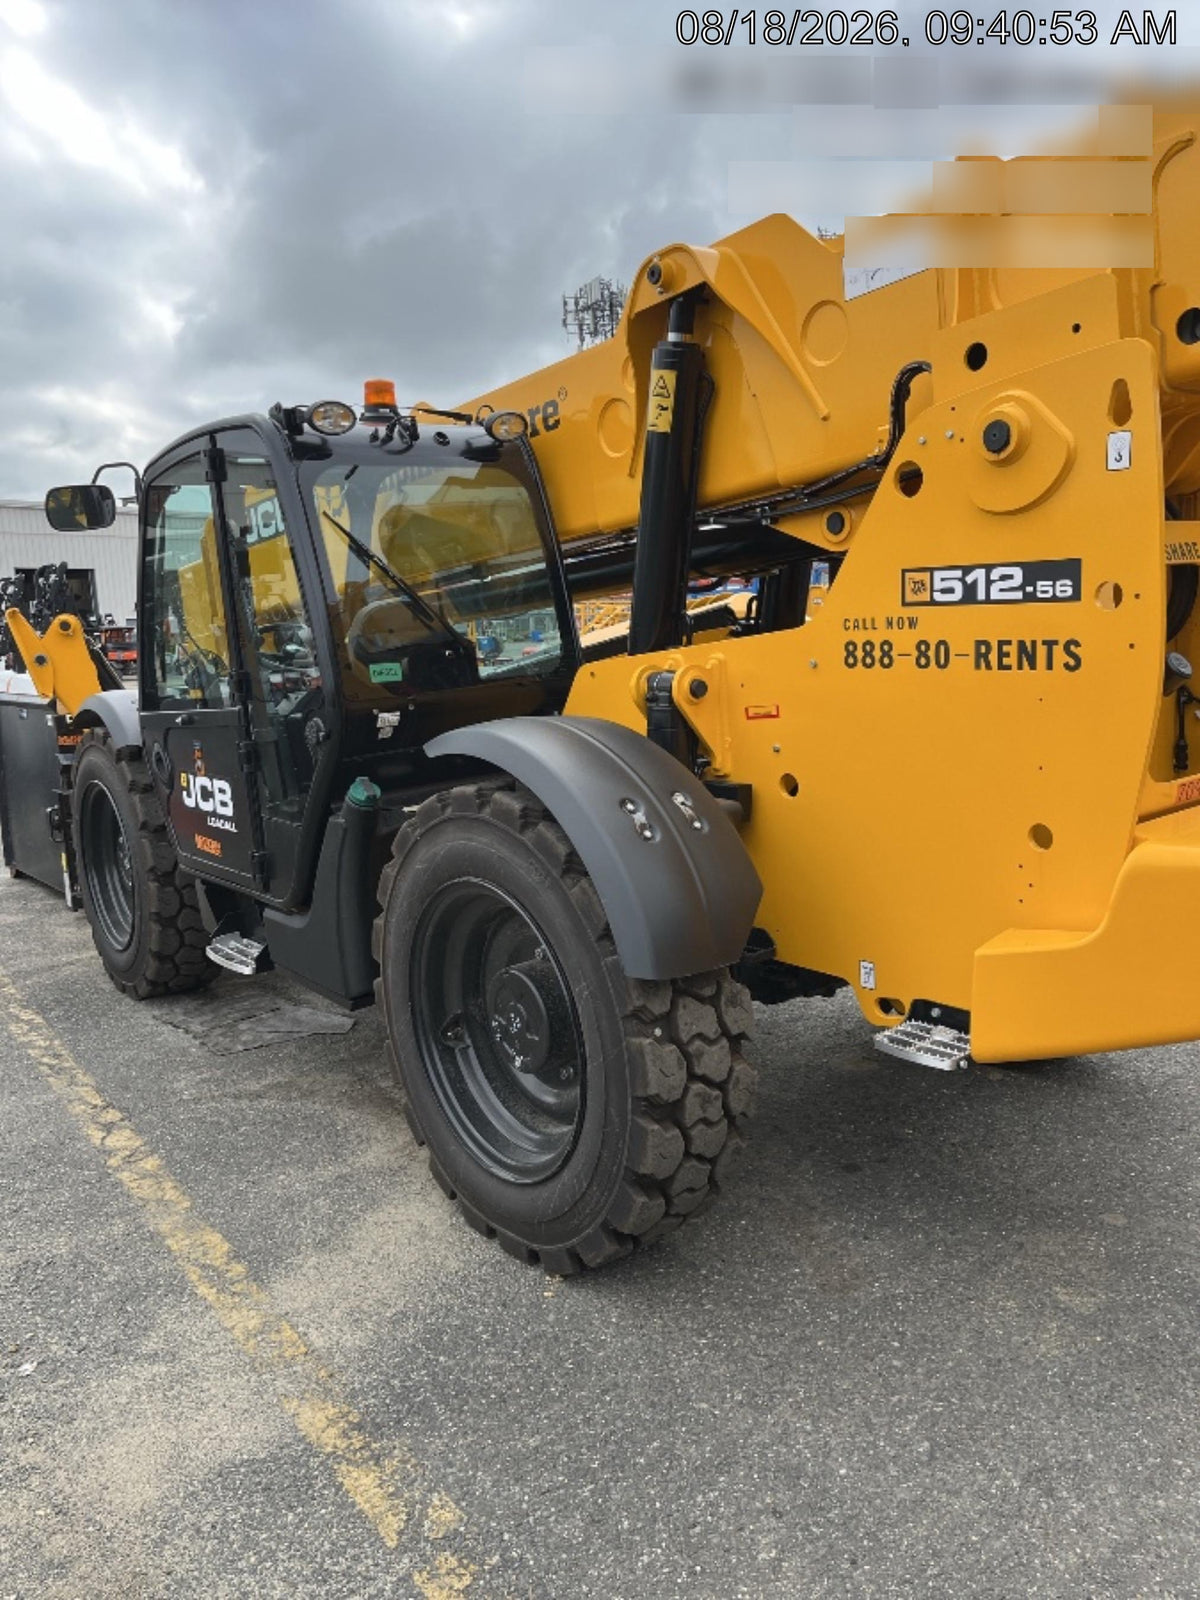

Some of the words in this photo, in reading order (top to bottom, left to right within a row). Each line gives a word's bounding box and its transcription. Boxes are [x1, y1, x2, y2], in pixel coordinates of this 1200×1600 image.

[932, 566, 1074, 602] 512-56
[843, 617, 878, 632] CALL
[885, 615, 918, 631] NOW
[843, 637, 1083, 673] 888-80-RENTS
[182, 774, 234, 817] JCB
